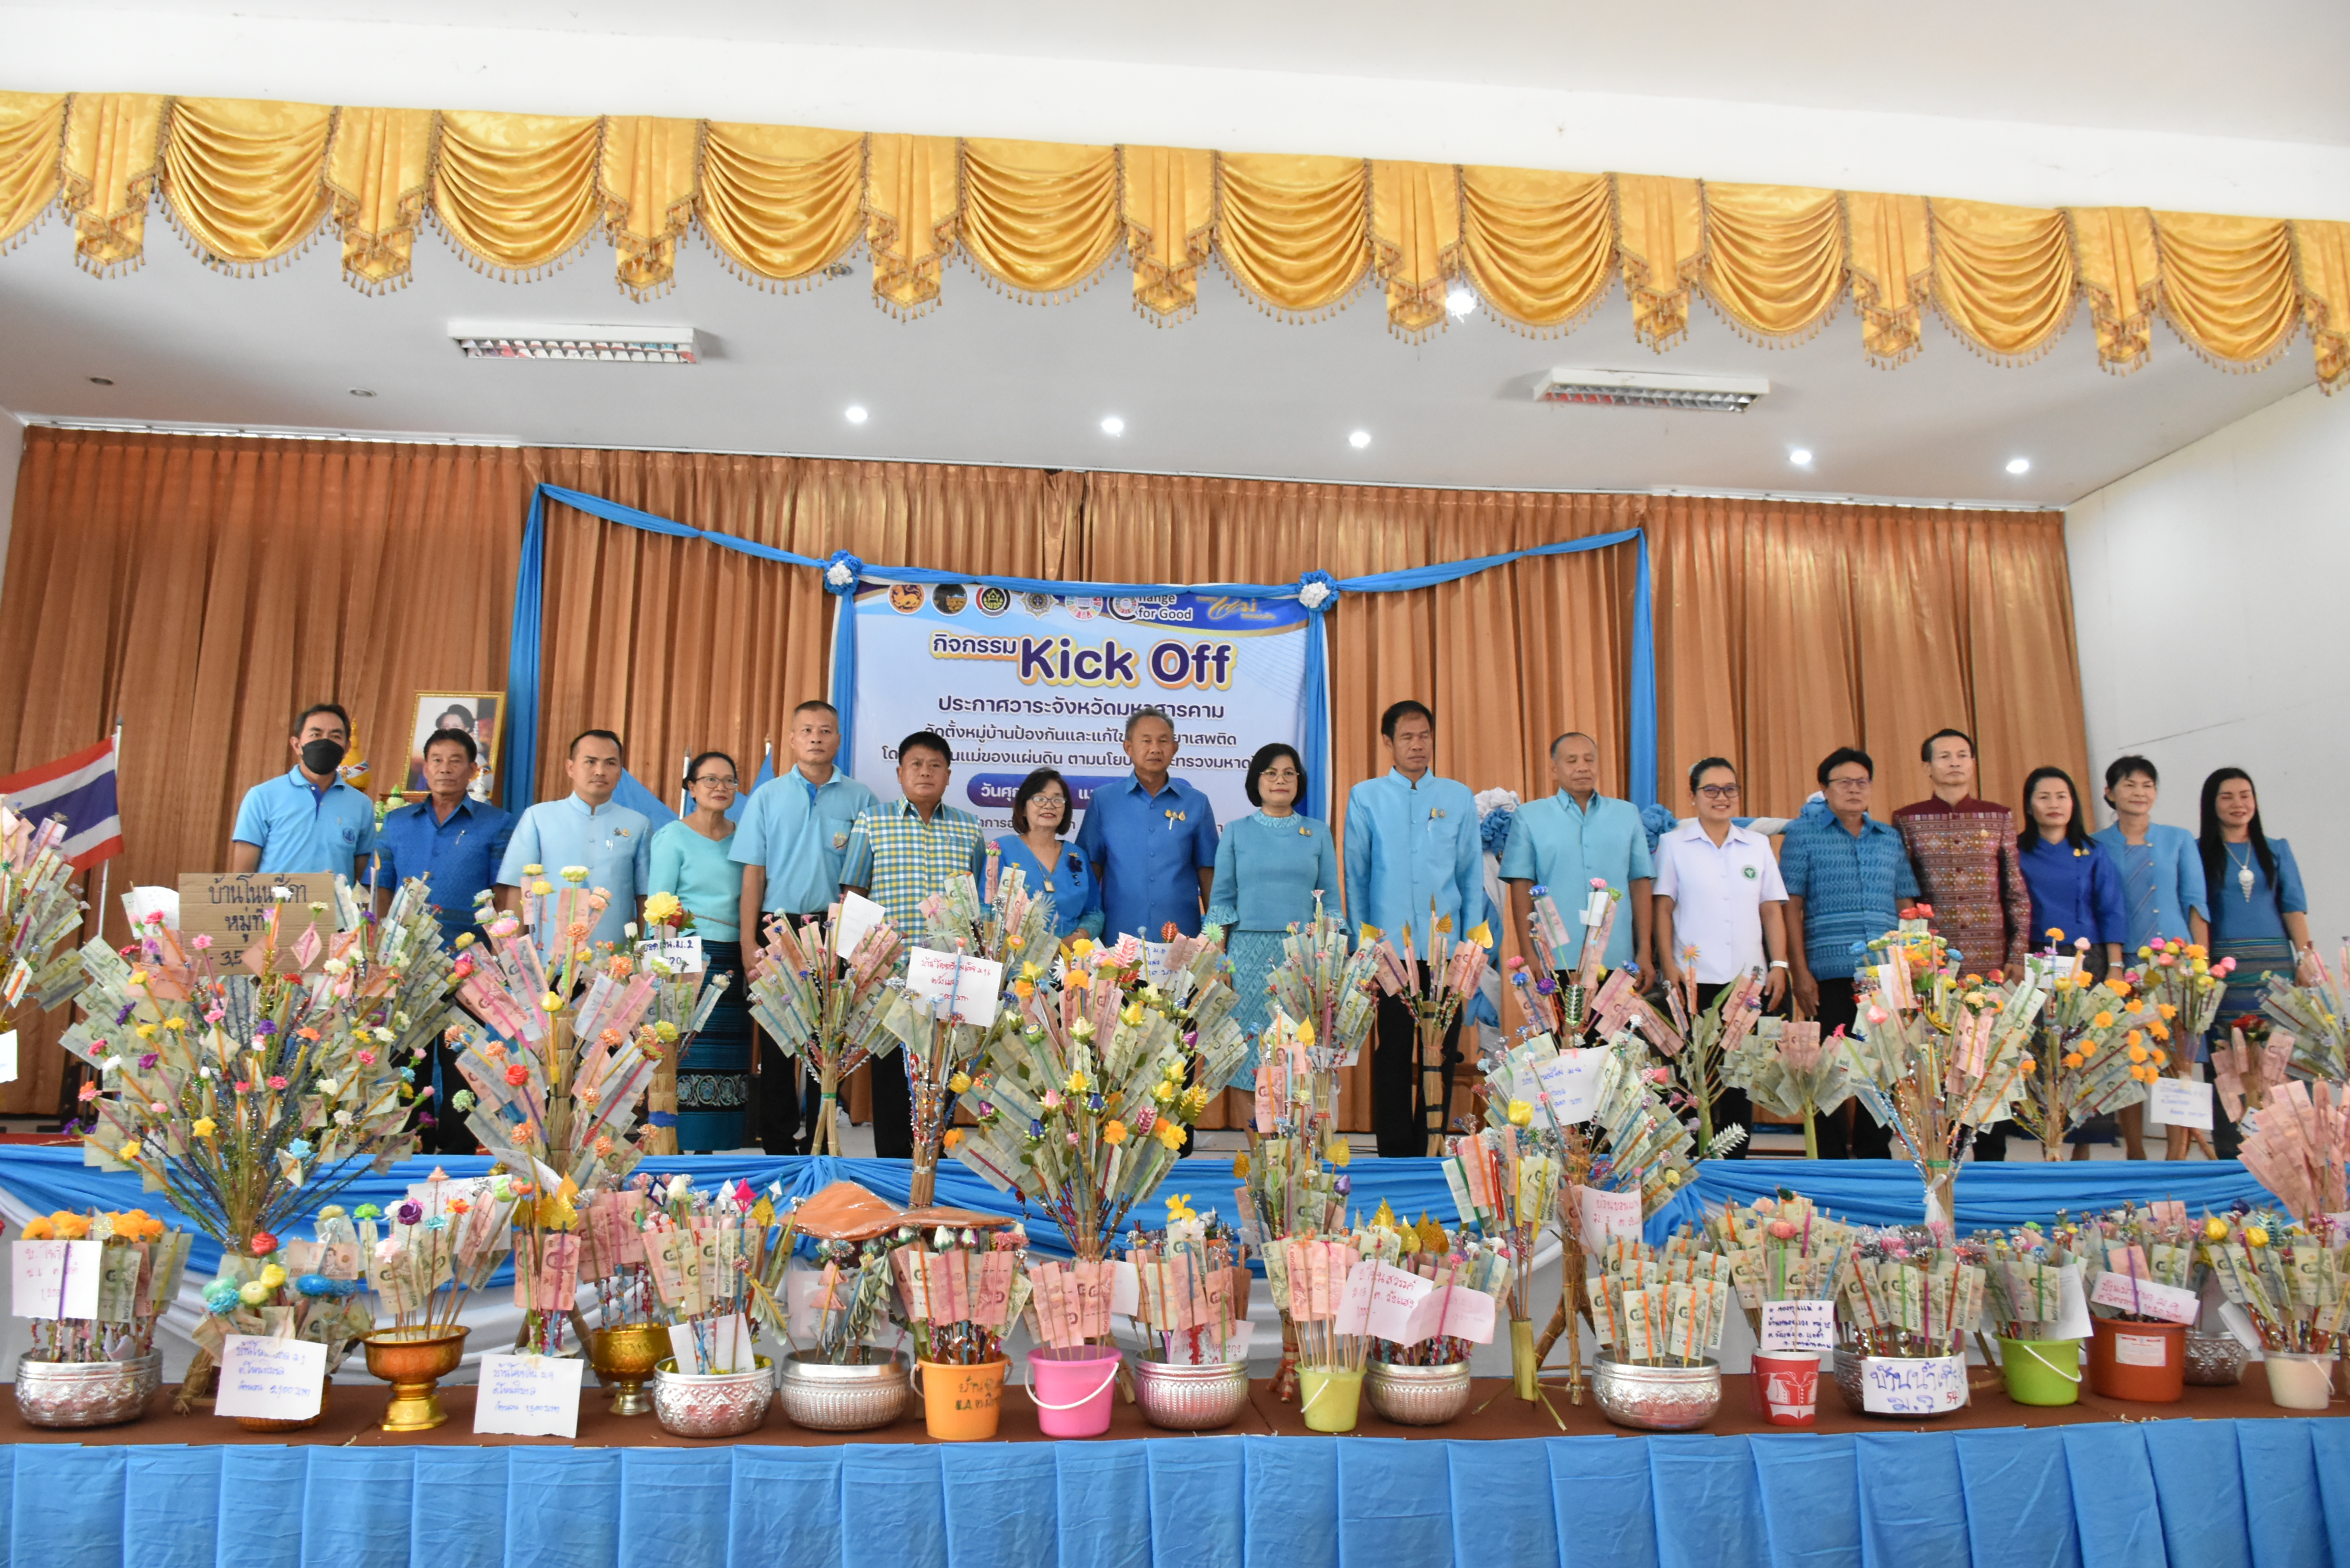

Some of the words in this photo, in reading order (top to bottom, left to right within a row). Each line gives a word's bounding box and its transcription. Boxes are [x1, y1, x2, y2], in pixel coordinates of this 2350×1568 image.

[1138, 607, 1157, 618] for
[1159, 608, 1192, 620] Good
[933, 633, 1017, 654] กิจกรรม
[1021, 638, 1134, 682] Kick
[1151, 642, 1231, 683] Off
